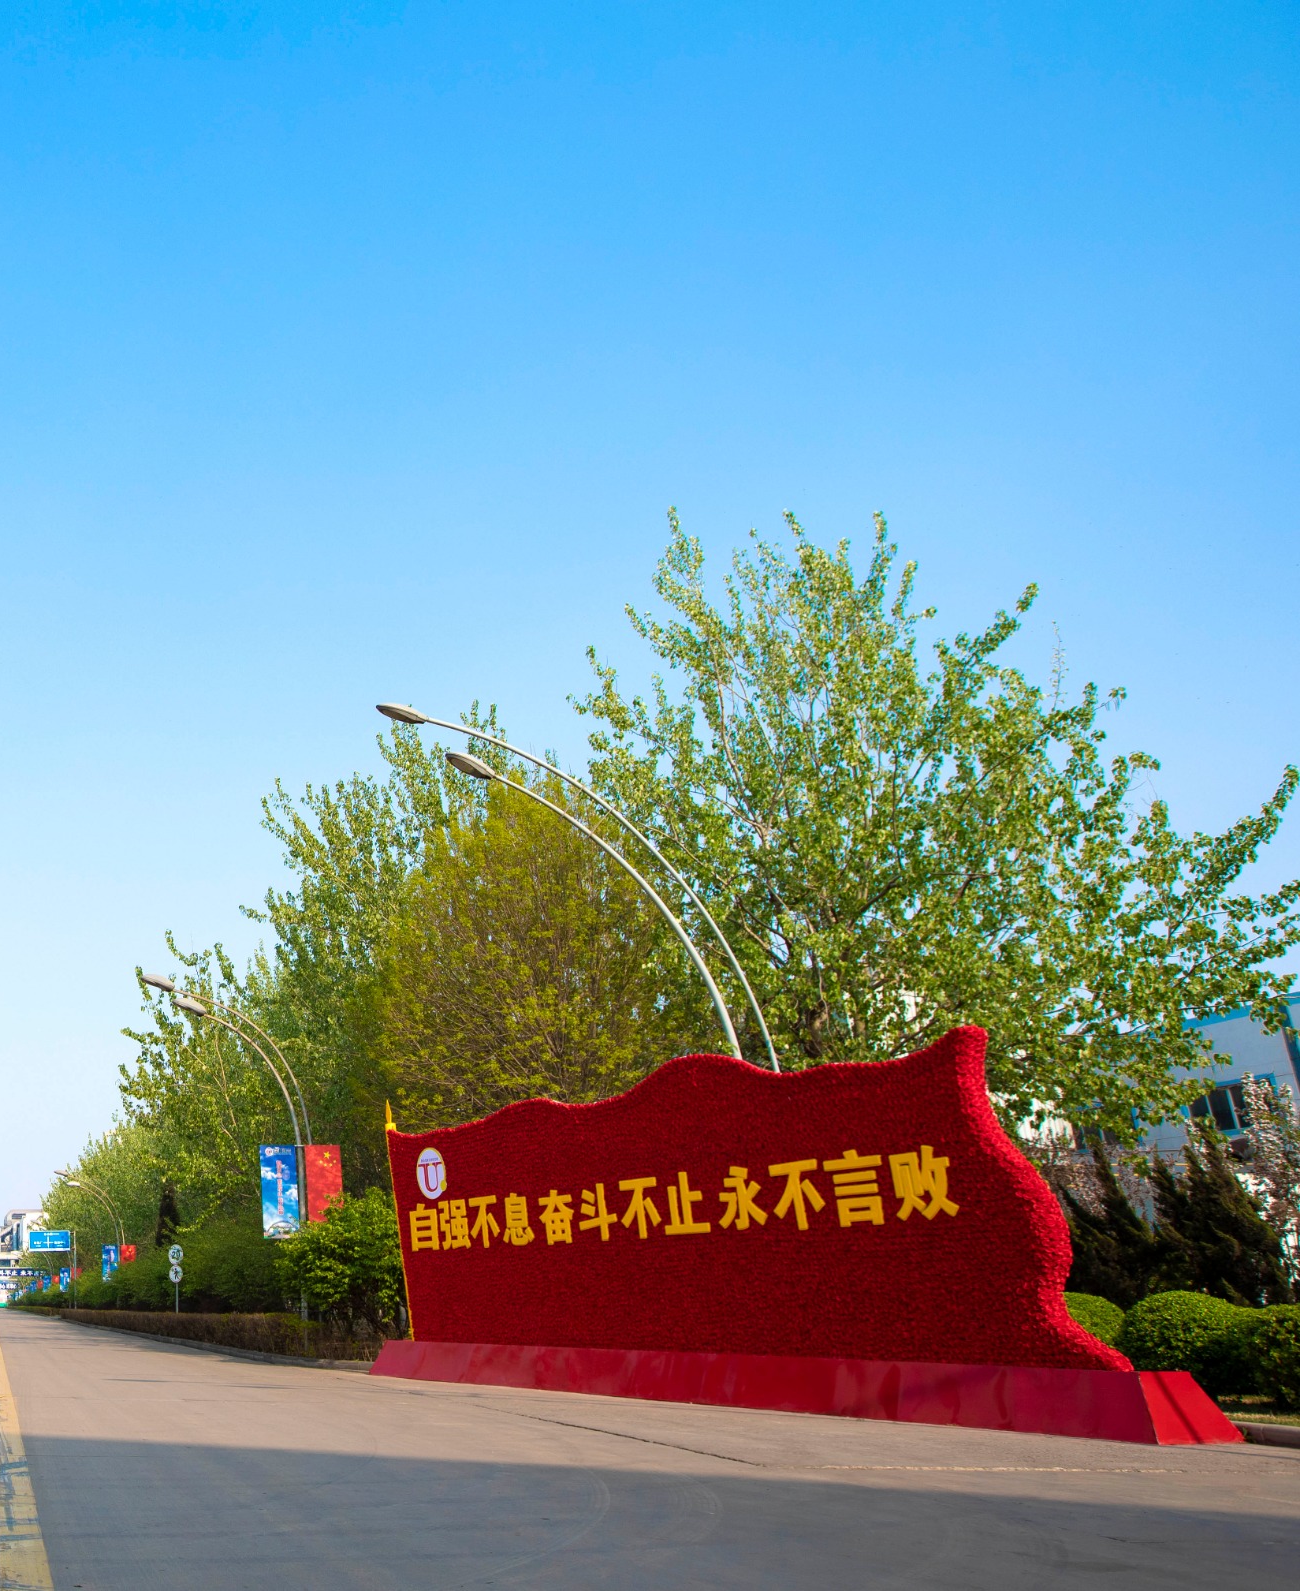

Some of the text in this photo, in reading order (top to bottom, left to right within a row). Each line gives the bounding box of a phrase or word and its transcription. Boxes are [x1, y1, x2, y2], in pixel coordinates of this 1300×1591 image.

[409, 1144, 960, 1252] 自强不息奋斗不止永不言败
